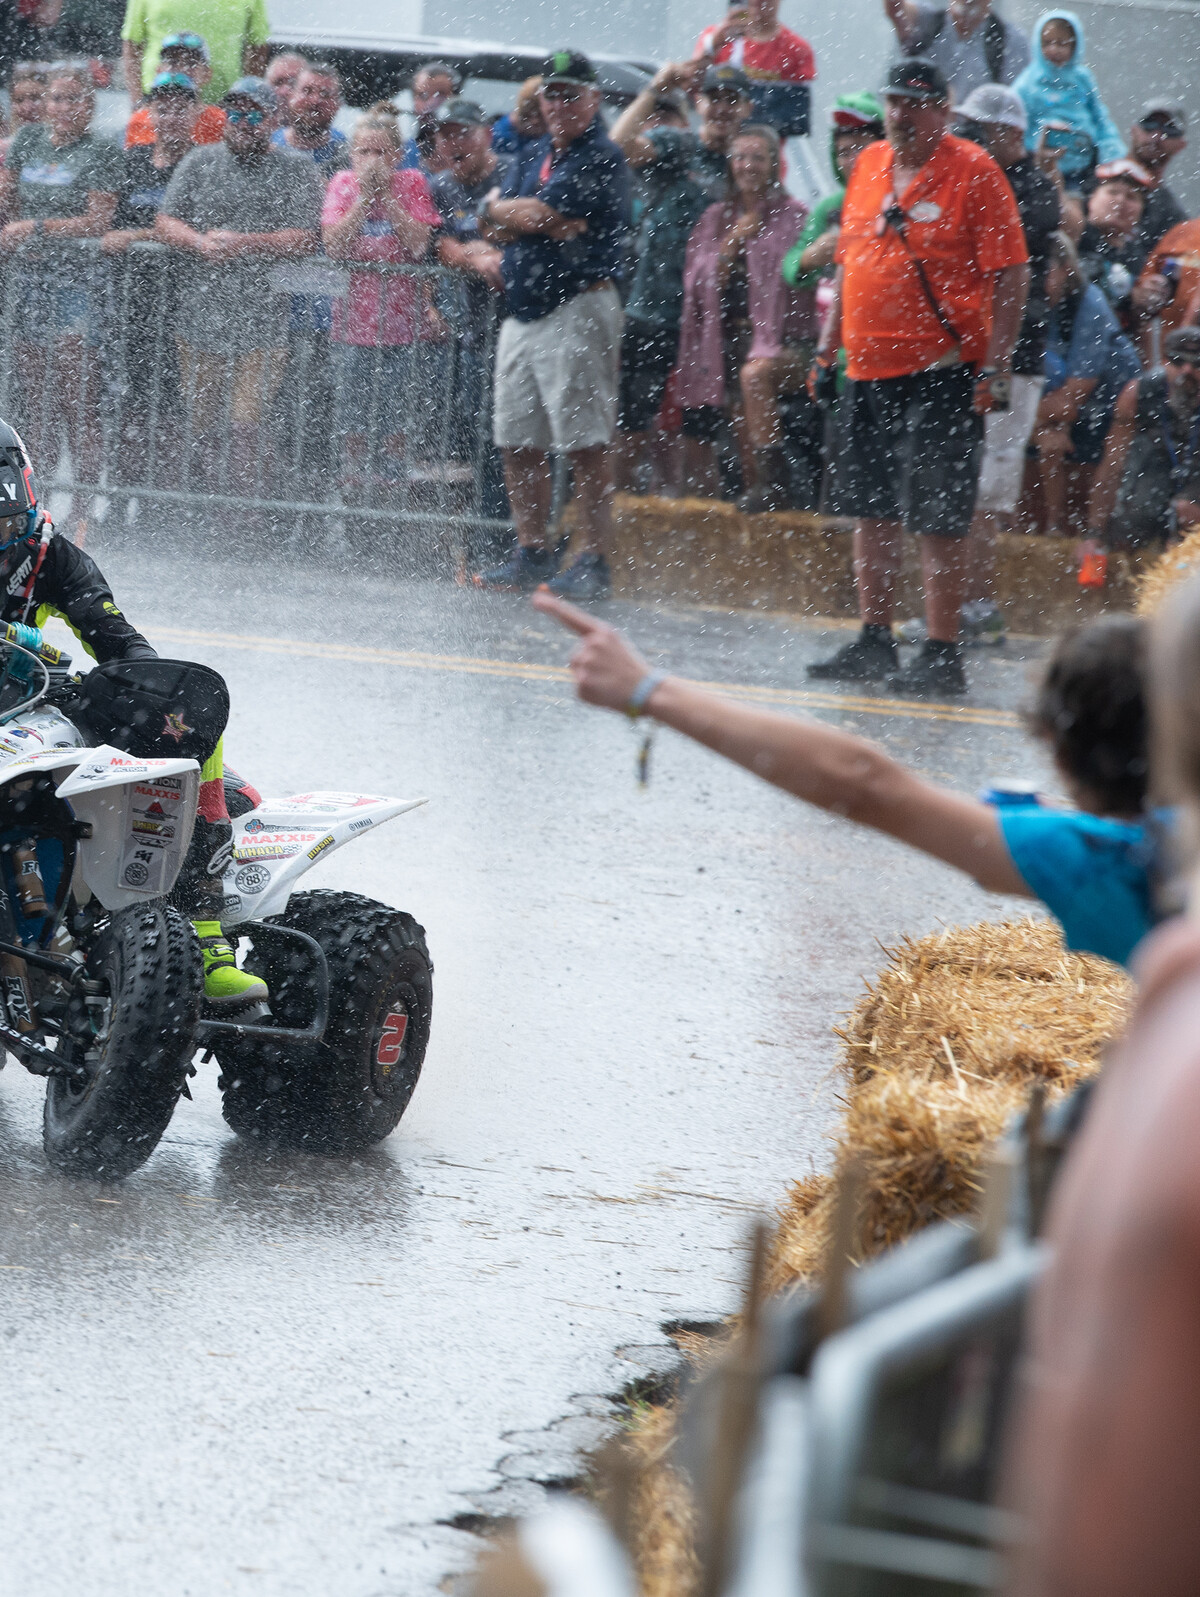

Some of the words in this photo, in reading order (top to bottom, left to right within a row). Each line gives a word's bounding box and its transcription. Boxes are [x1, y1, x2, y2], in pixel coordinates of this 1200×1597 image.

[110, 757, 167, 766] MAXXIS
[134, 786, 181, 800] MAXXIS
[241, 833, 317, 845] MAXXIS
[307, 835, 334, 860] HINSON
[246, 873, 261, 886] 88
[5, 976, 32, 1024] FOX
[377, 1013, 409, 1065] 2
